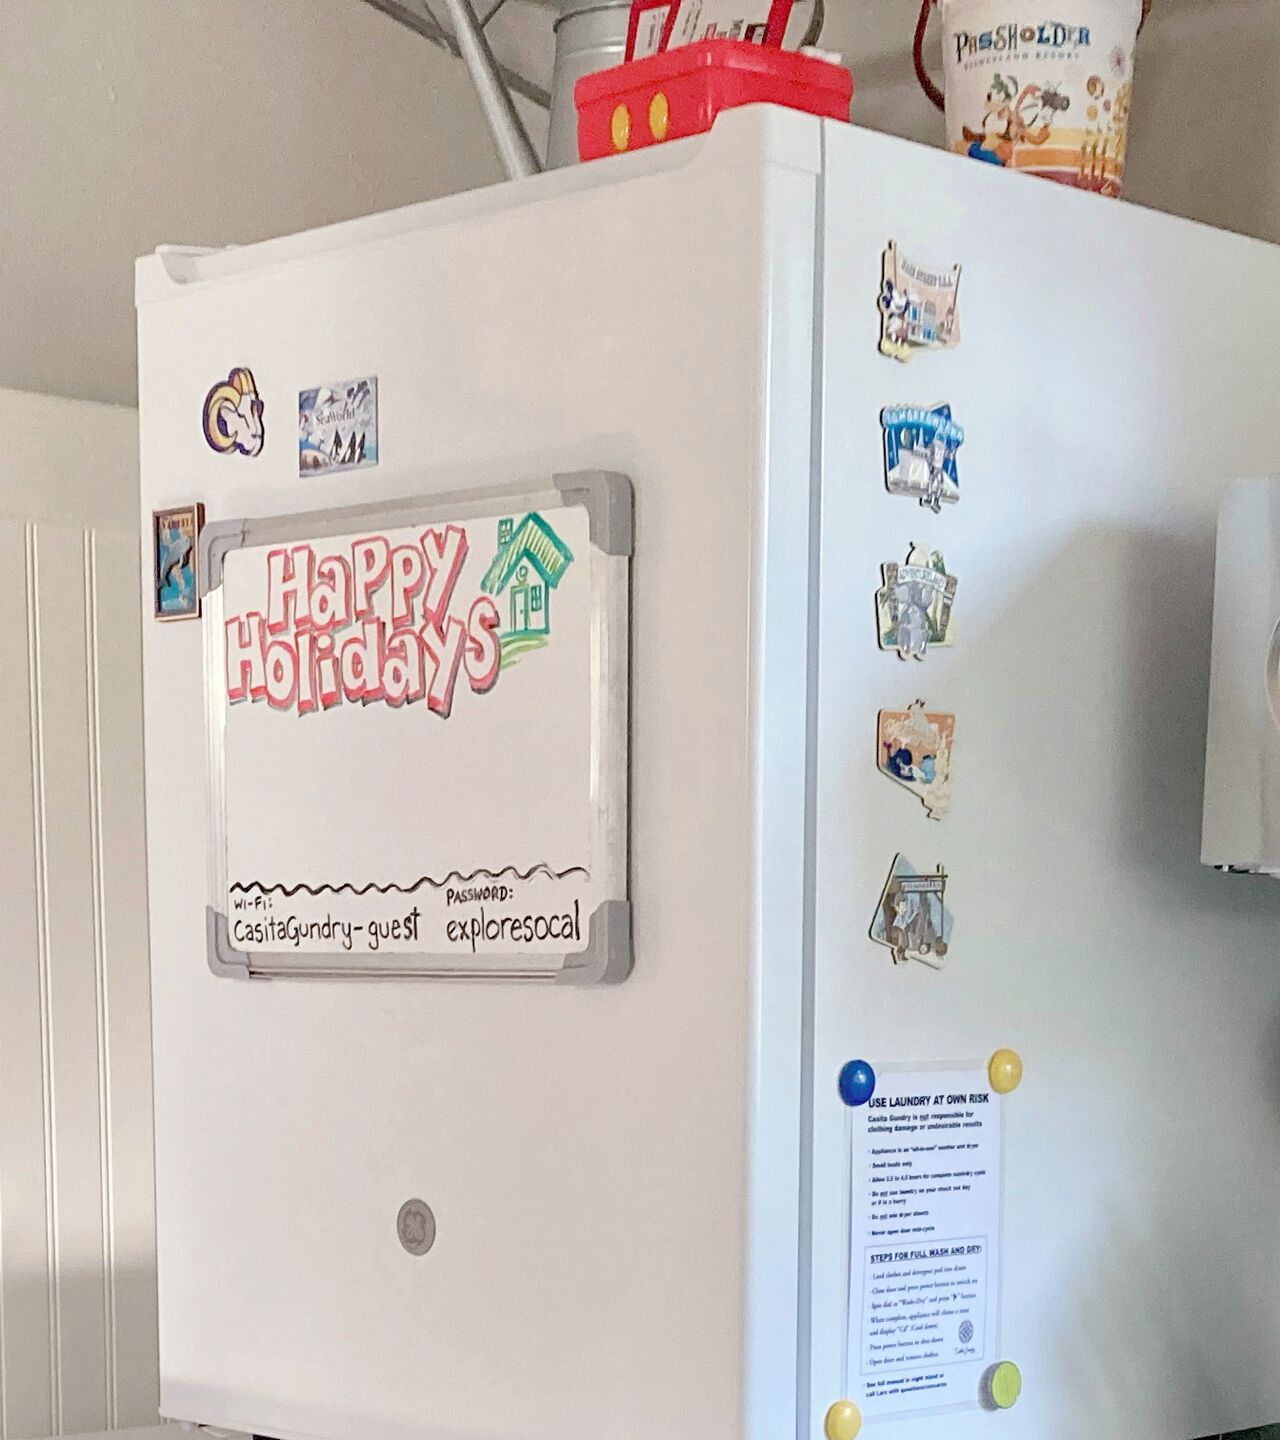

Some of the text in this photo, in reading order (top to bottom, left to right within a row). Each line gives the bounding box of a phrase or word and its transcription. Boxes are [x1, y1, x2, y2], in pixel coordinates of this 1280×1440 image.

[953, 19, 1091, 63] PASSHOLDER
[446, 886, 514, 906] PASSWORD:
[446, 900, 581, 953] exploresocal
[869, 1093, 989, 1107] USE LAUNDRY AT OWN RISK
[931, 1112, 964, 1120] responsible
[871, 1253, 892, 1264] STEPS
[895, 1252, 908, 1260] FOR
[911, 1251, 927, 1259] FULL
[929, 1248, 948, 1257] WASH
[951, 1246, 964, 1254] AND
